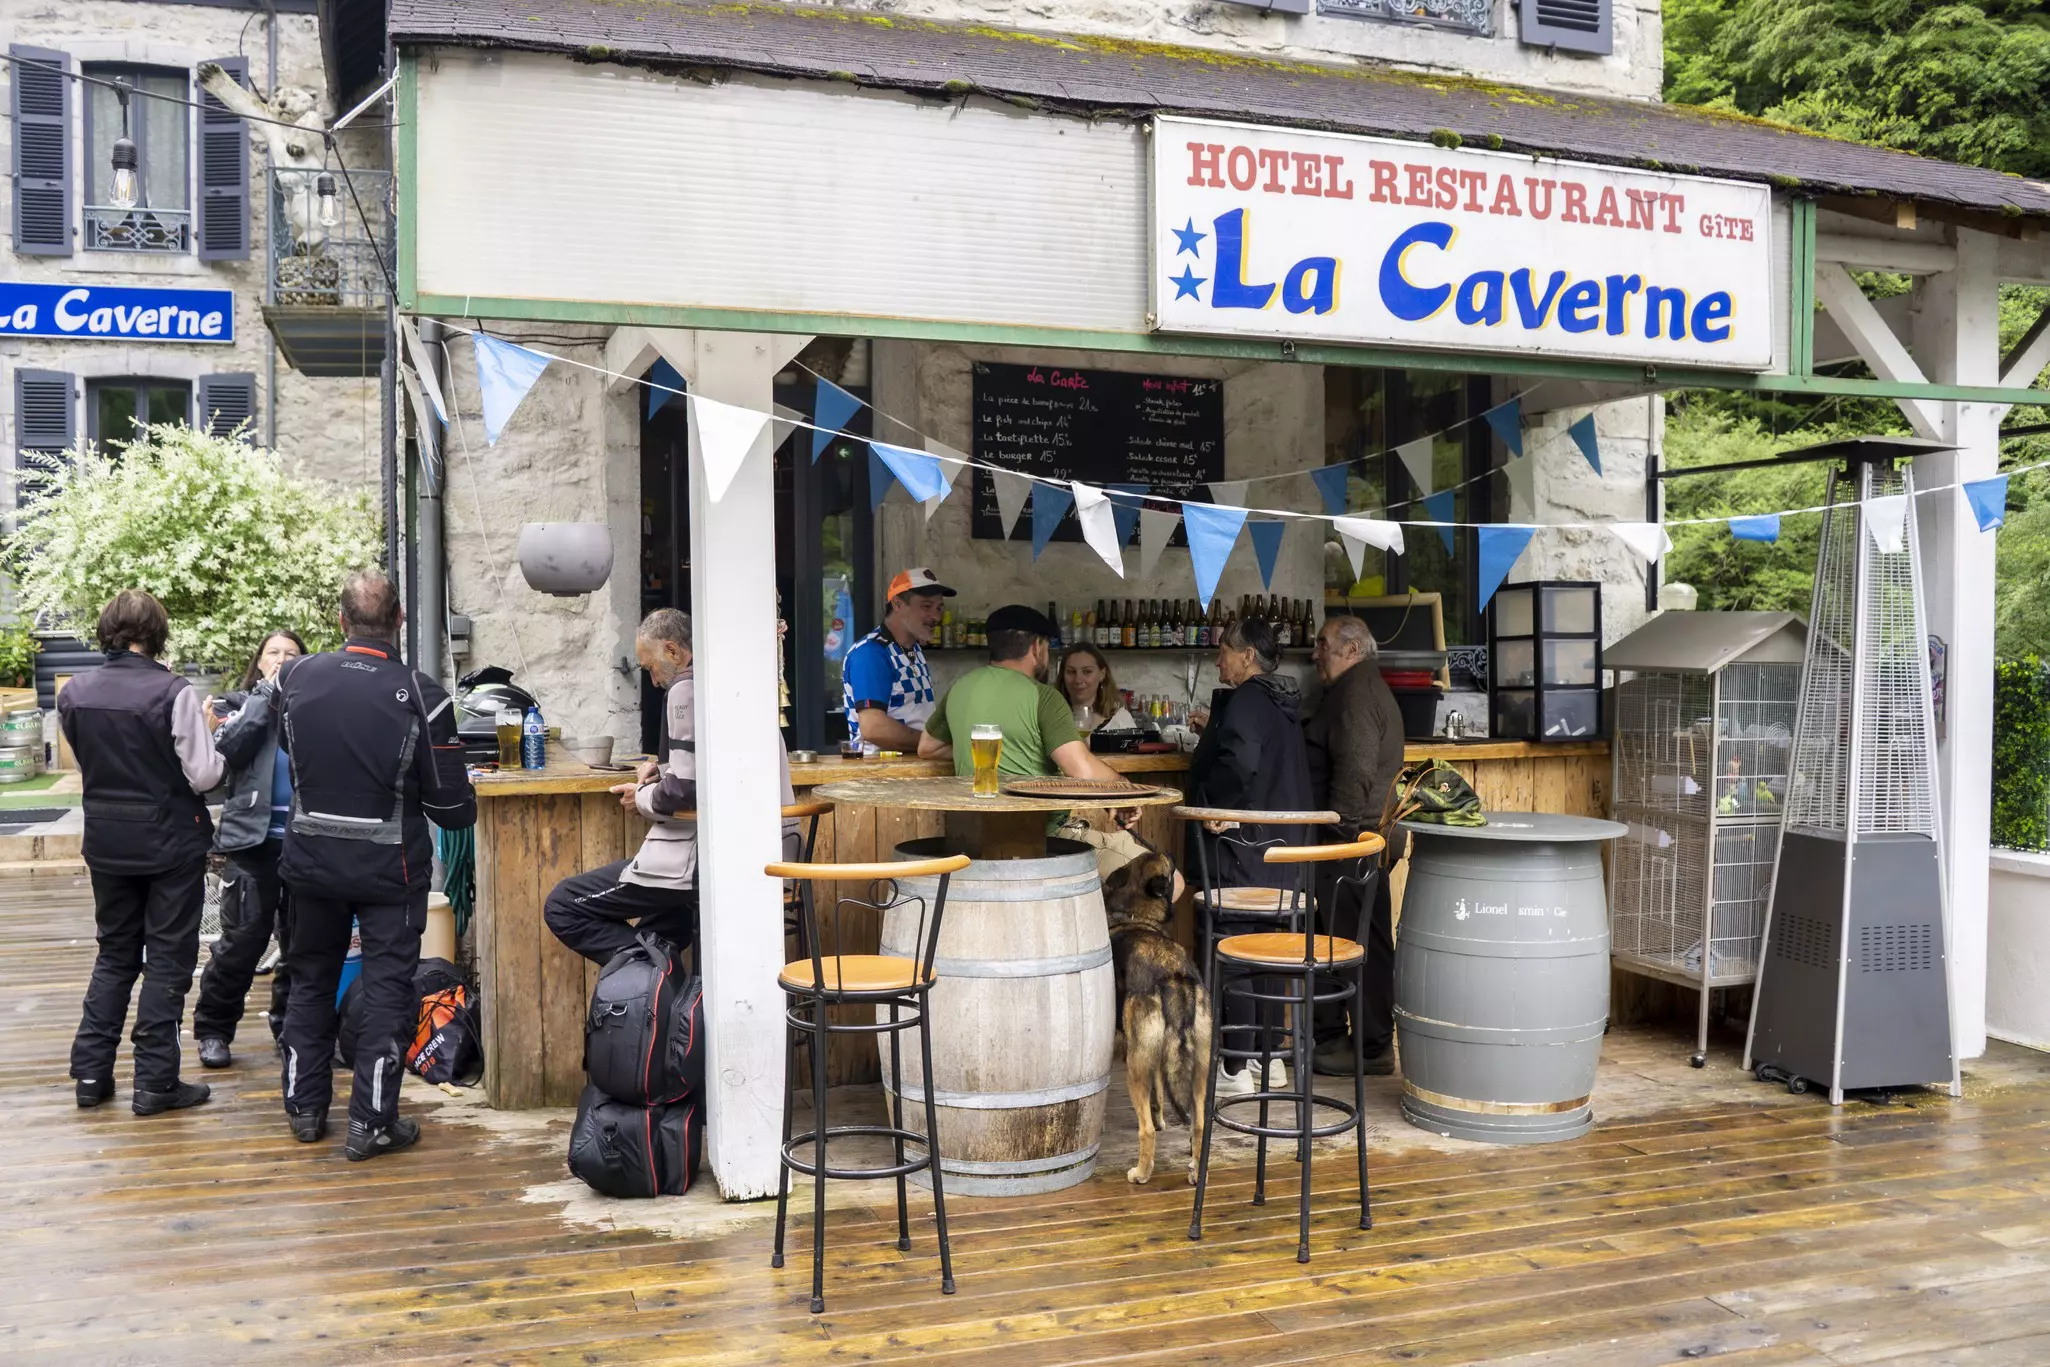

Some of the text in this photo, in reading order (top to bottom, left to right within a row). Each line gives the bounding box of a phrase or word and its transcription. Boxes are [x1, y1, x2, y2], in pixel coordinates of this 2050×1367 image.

[1187, 142, 1353, 199] HOTEL
[1369, 160, 1684, 233] RESTAURANT
[1212, 208, 1736, 343] La Caverne
[55, 288, 223, 336] Caverne
[1027, 366, 1090, 390] La Carte
[983, 393, 993, 402] La
[1474, 902, 1508, 915] Lionel
[424, 1033, 445, 1056] CREW
